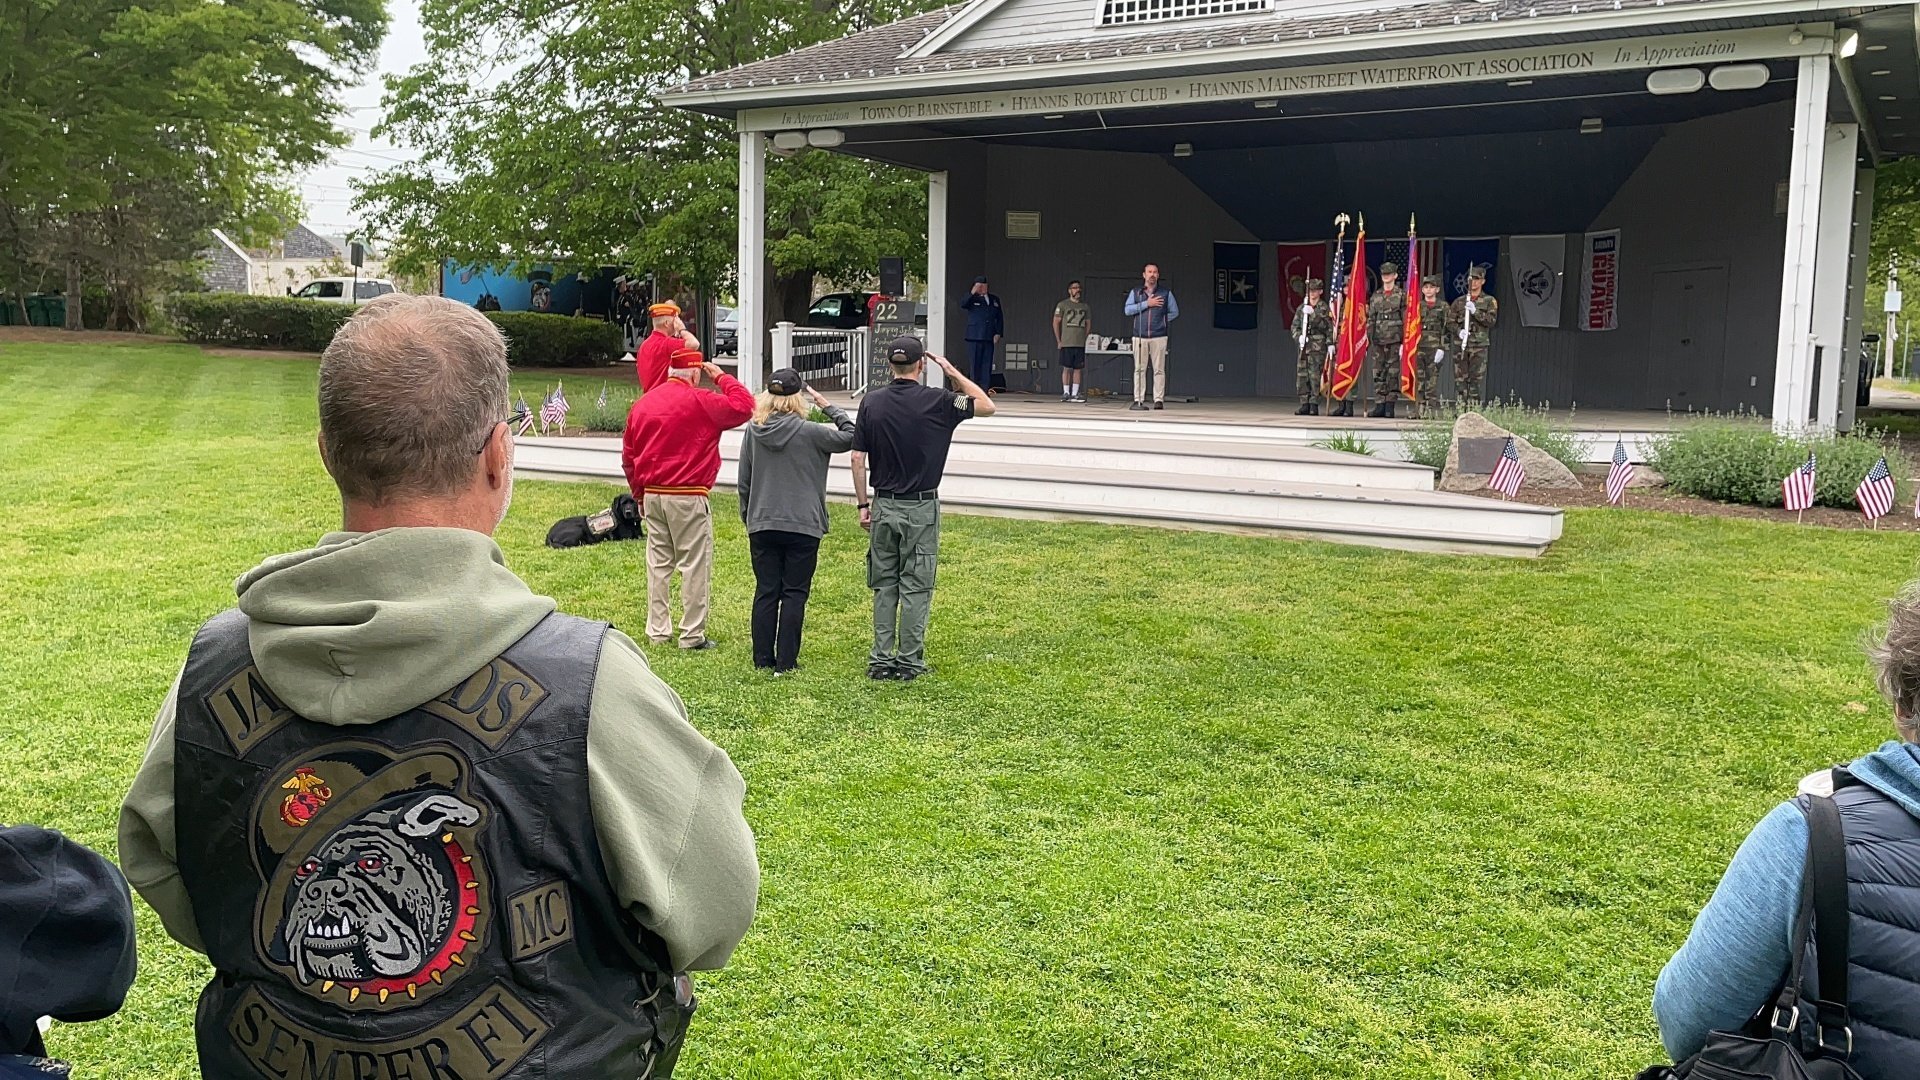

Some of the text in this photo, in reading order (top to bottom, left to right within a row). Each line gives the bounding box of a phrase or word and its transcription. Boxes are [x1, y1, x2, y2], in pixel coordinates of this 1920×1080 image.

[1613, 40, 1736, 65] In Appreciation
[1188, 51, 1594, 98] HYANNIS MAINSTREET WATERFRONT ASSOCIATION
[859, 106, 896, 120] TOWN
[917, 100, 993, 117] BARNSTABLE
[1011, 87, 1168, 111] HYANNIS ROTARY CLUB
[781, 109, 851, 127] In Appreciation
[1589, 254, 1607, 328] GUARD
[1605, 253, 1616, 309] NATIONAL
[876, 303, 898, 320] 22
[1066, 308, 1086, 328] 22
[516, 888, 567, 951] MC
[234, 992, 538, 1080] SEMPER FI
